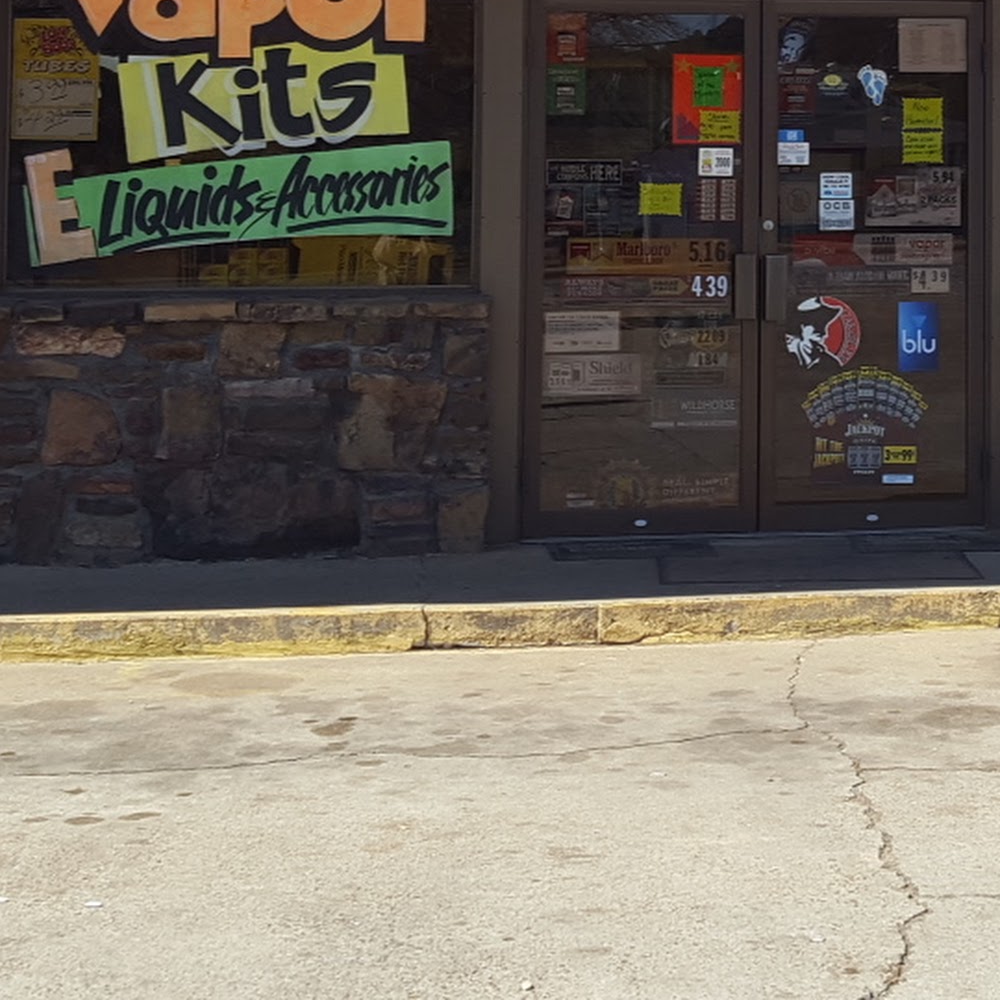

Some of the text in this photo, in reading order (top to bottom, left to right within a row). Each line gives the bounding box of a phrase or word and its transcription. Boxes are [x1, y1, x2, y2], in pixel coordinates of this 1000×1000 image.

[23, 59, 92, 74] TUBES
[155, 47, 377, 148] Kits
[589, 164, 620, 181] HERE
[98, 163, 260, 249] Liquids
[270, 155, 451, 227] Accessories
[615, 242, 672, 256] Marlboro
[902, 328, 938, 355] blu
